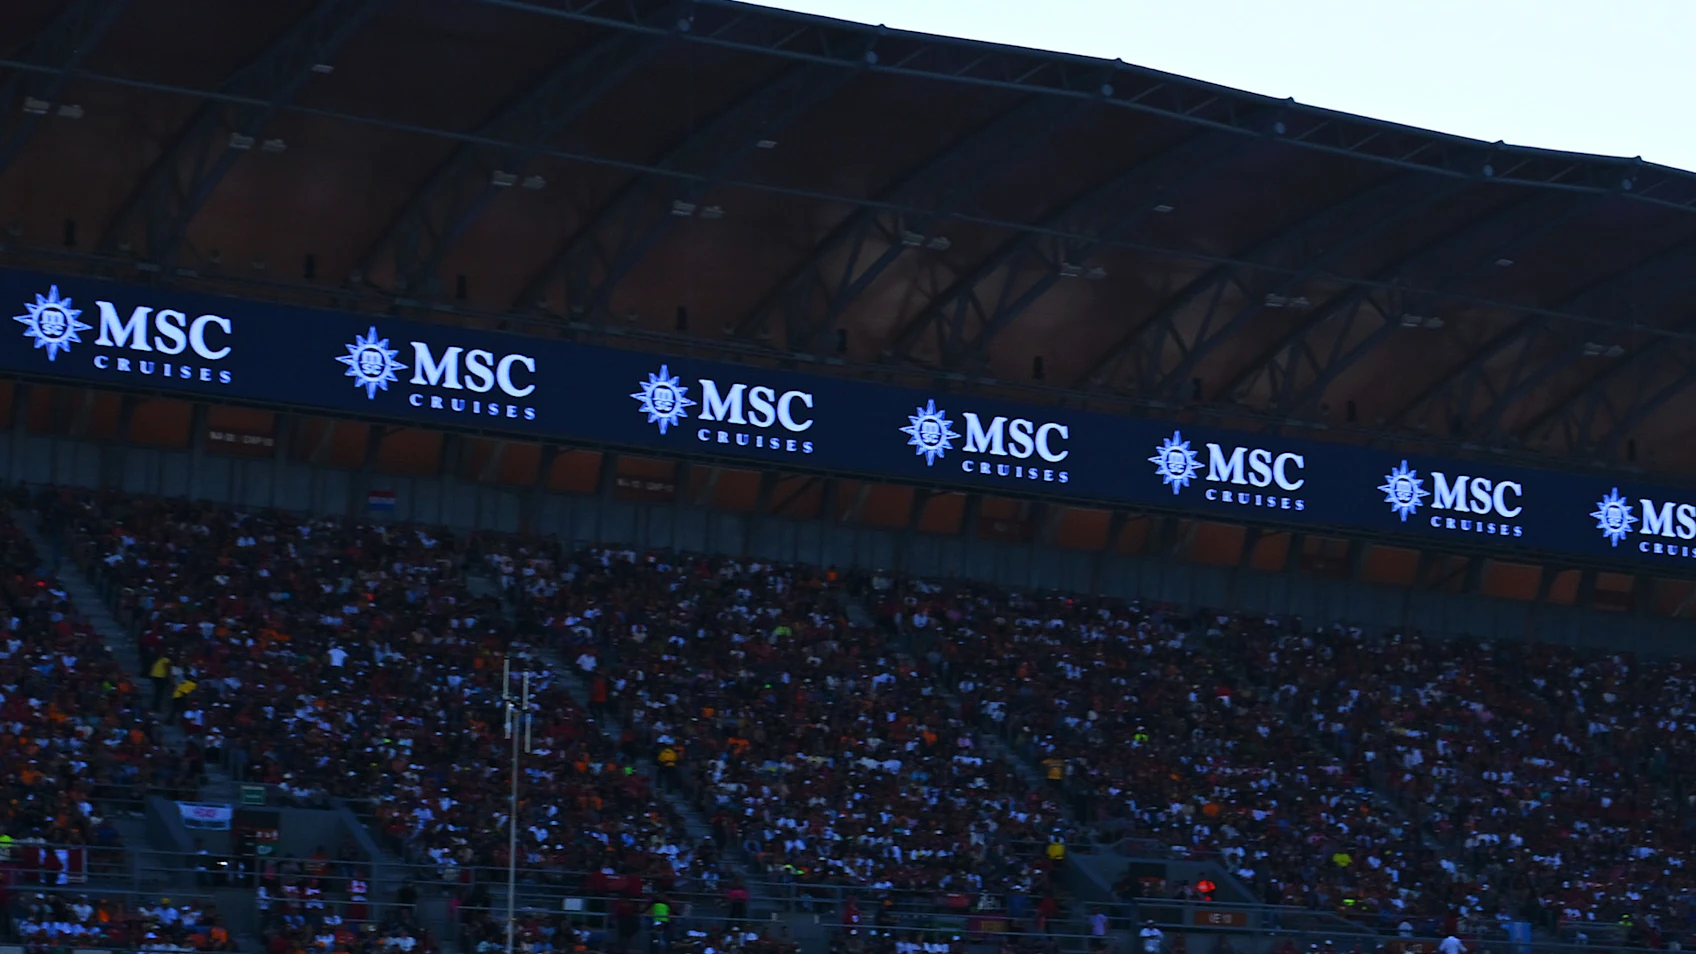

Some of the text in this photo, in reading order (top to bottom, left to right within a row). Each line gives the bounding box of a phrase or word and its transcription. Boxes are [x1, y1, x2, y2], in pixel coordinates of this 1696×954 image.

[94, 301, 232, 360] MSC
[93, 354, 232, 384] CRUISES
[410, 342, 536, 397] MSC
[408, 393, 536, 421] CRUISES
[698, 379, 813, 431] MSC
[697, 428, 814, 454] CRUISES
[962, 412, 1069, 462] MSC
[961, 459, 1069, 484] CRUISES
[1206, 443, 1304, 490] MSC
[1205, 488, 1305, 511] CRUISES
[1431, 472, 1522, 517] MSC
[1429, 515, 1523, 537] CRUISES
